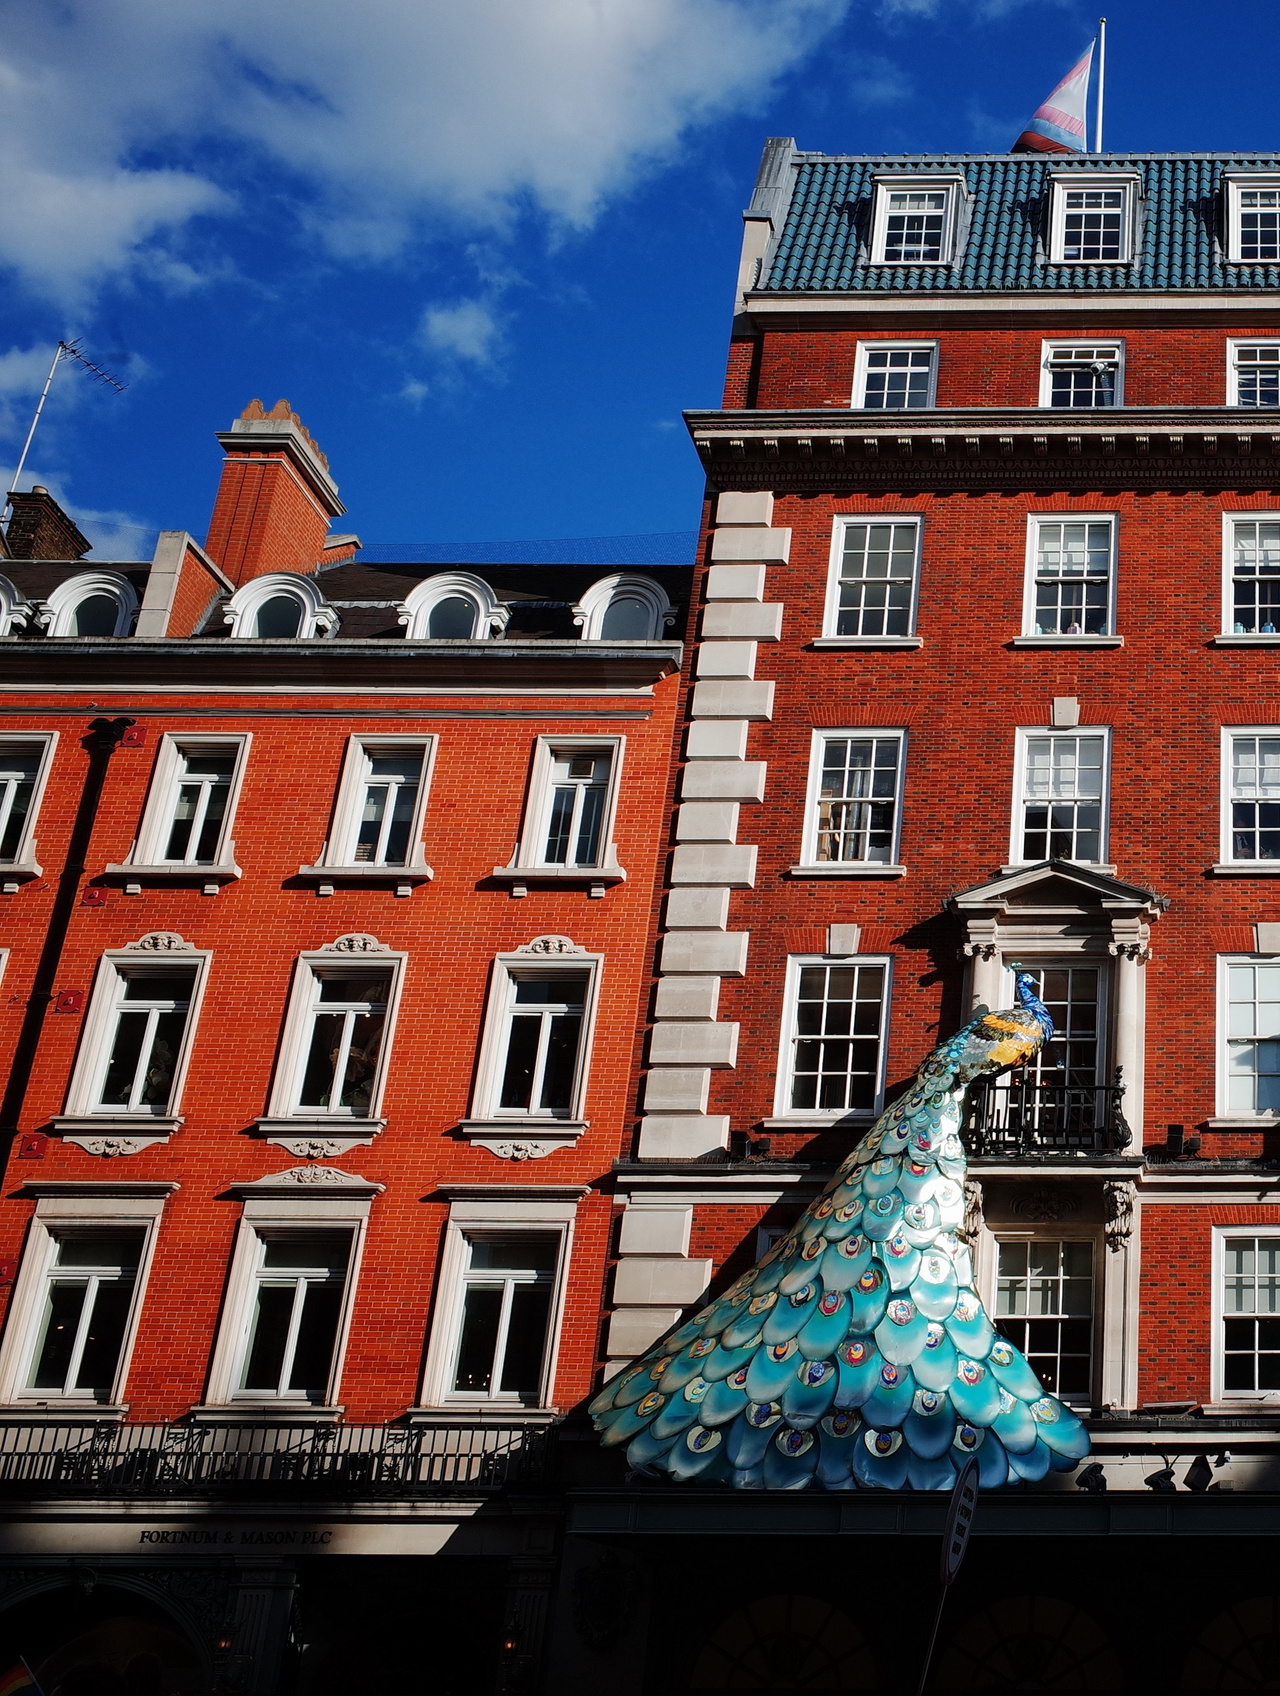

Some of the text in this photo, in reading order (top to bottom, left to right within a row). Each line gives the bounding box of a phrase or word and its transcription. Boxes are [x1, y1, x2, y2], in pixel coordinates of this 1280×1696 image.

[139, 1531, 333, 1544] FORTNUM & MASON PLC
